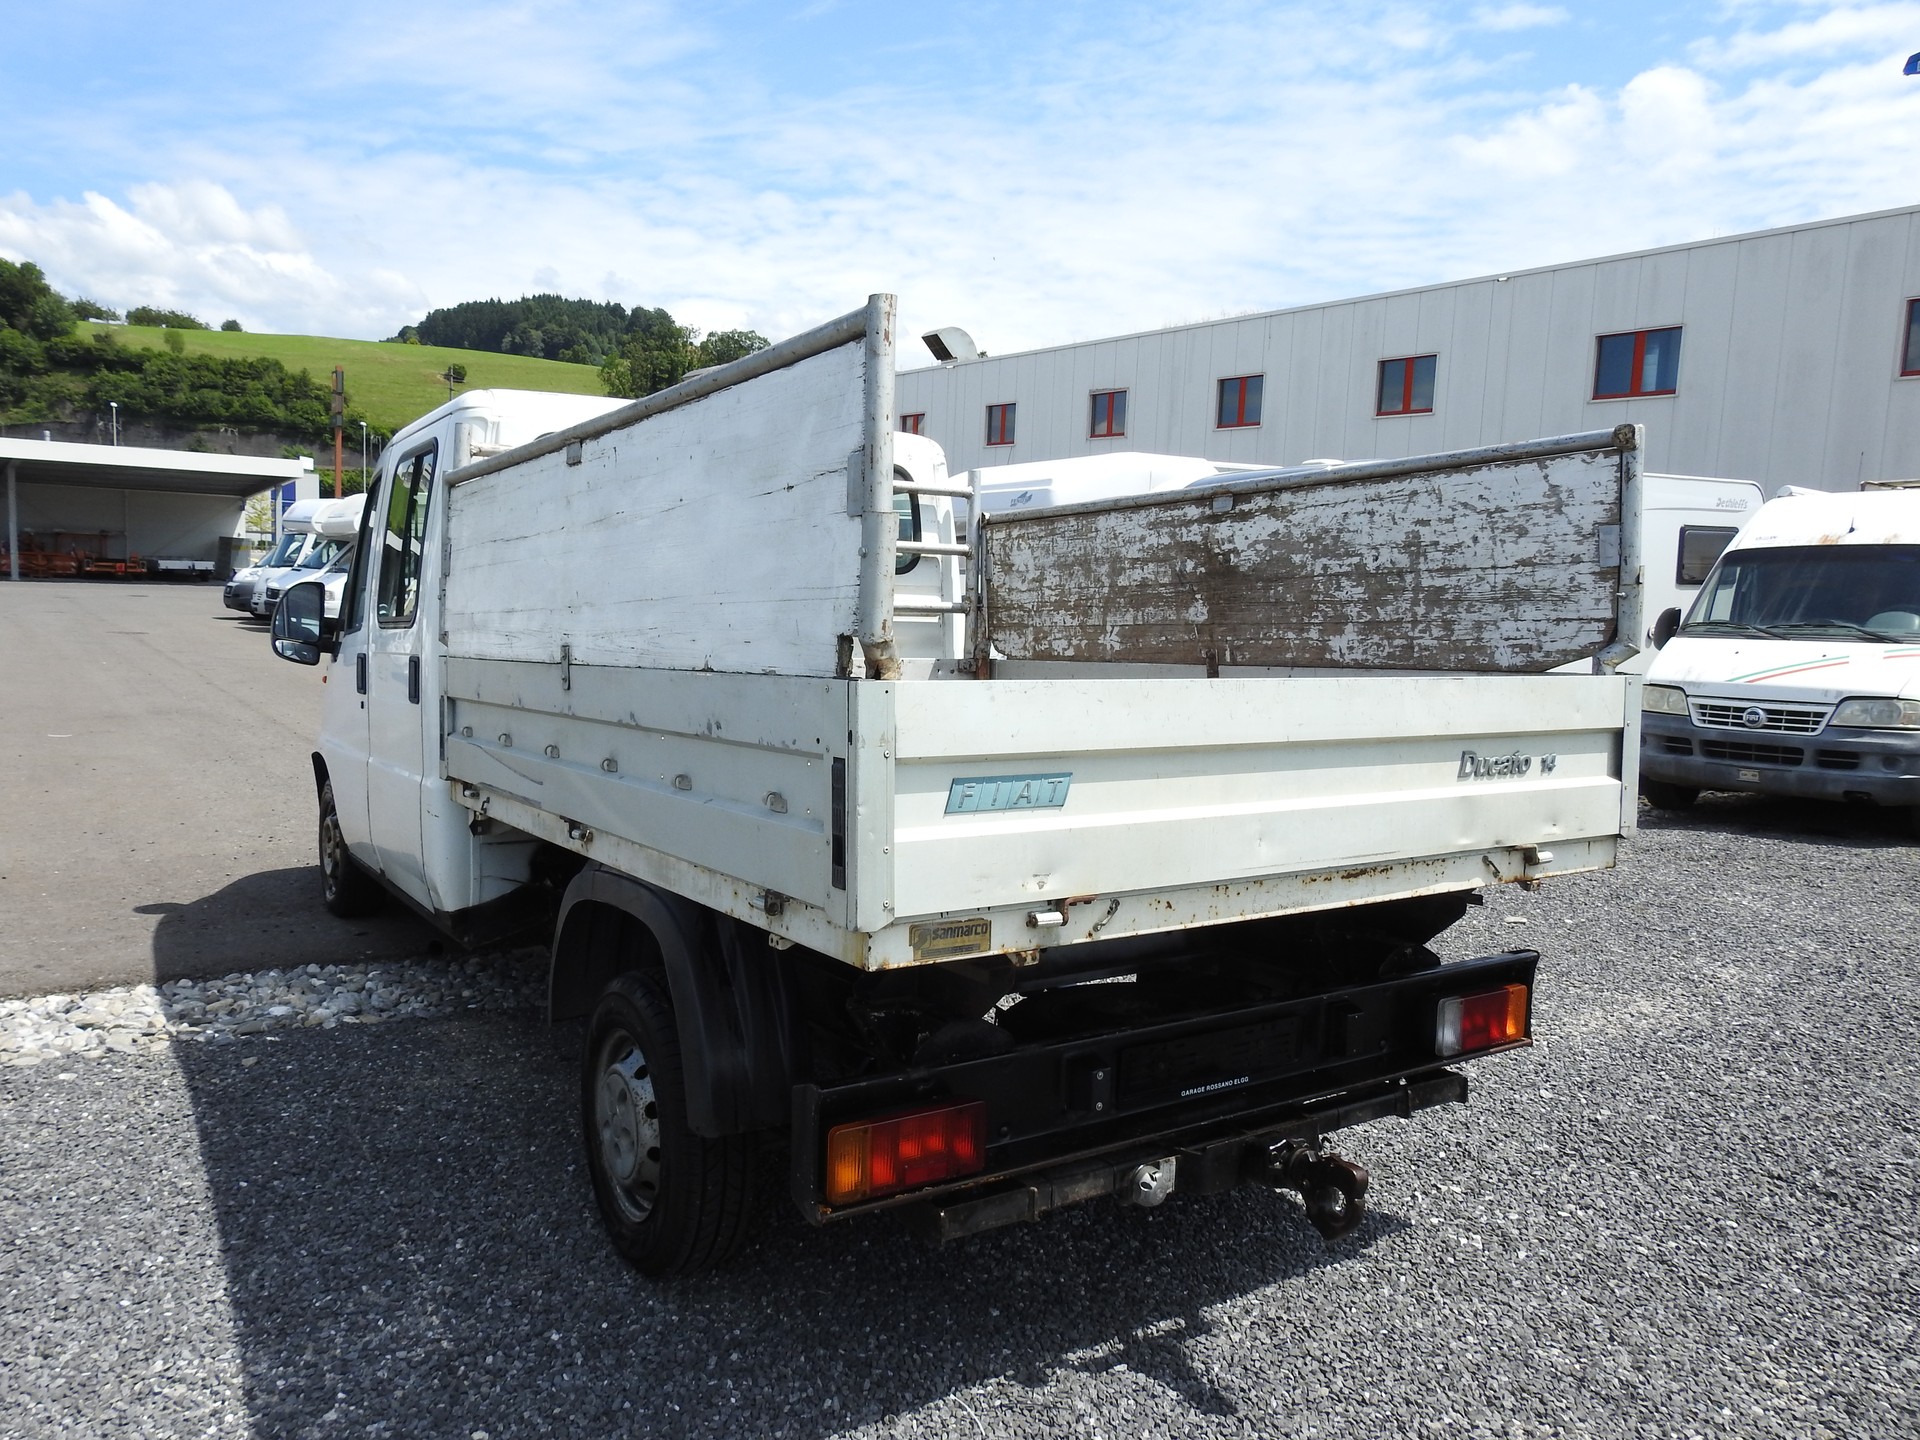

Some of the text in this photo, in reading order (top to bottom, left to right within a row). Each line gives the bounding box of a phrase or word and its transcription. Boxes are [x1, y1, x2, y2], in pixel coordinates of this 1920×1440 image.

[1457, 750, 1531, 778] Ducato
[958, 779, 1063, 808] FIAT
[932, 922, 988, 940] sanmarco
[1181, 1086, 1205, 1097] GARAGE
[1206, 1080, 1233, 1091] ROSSANO
